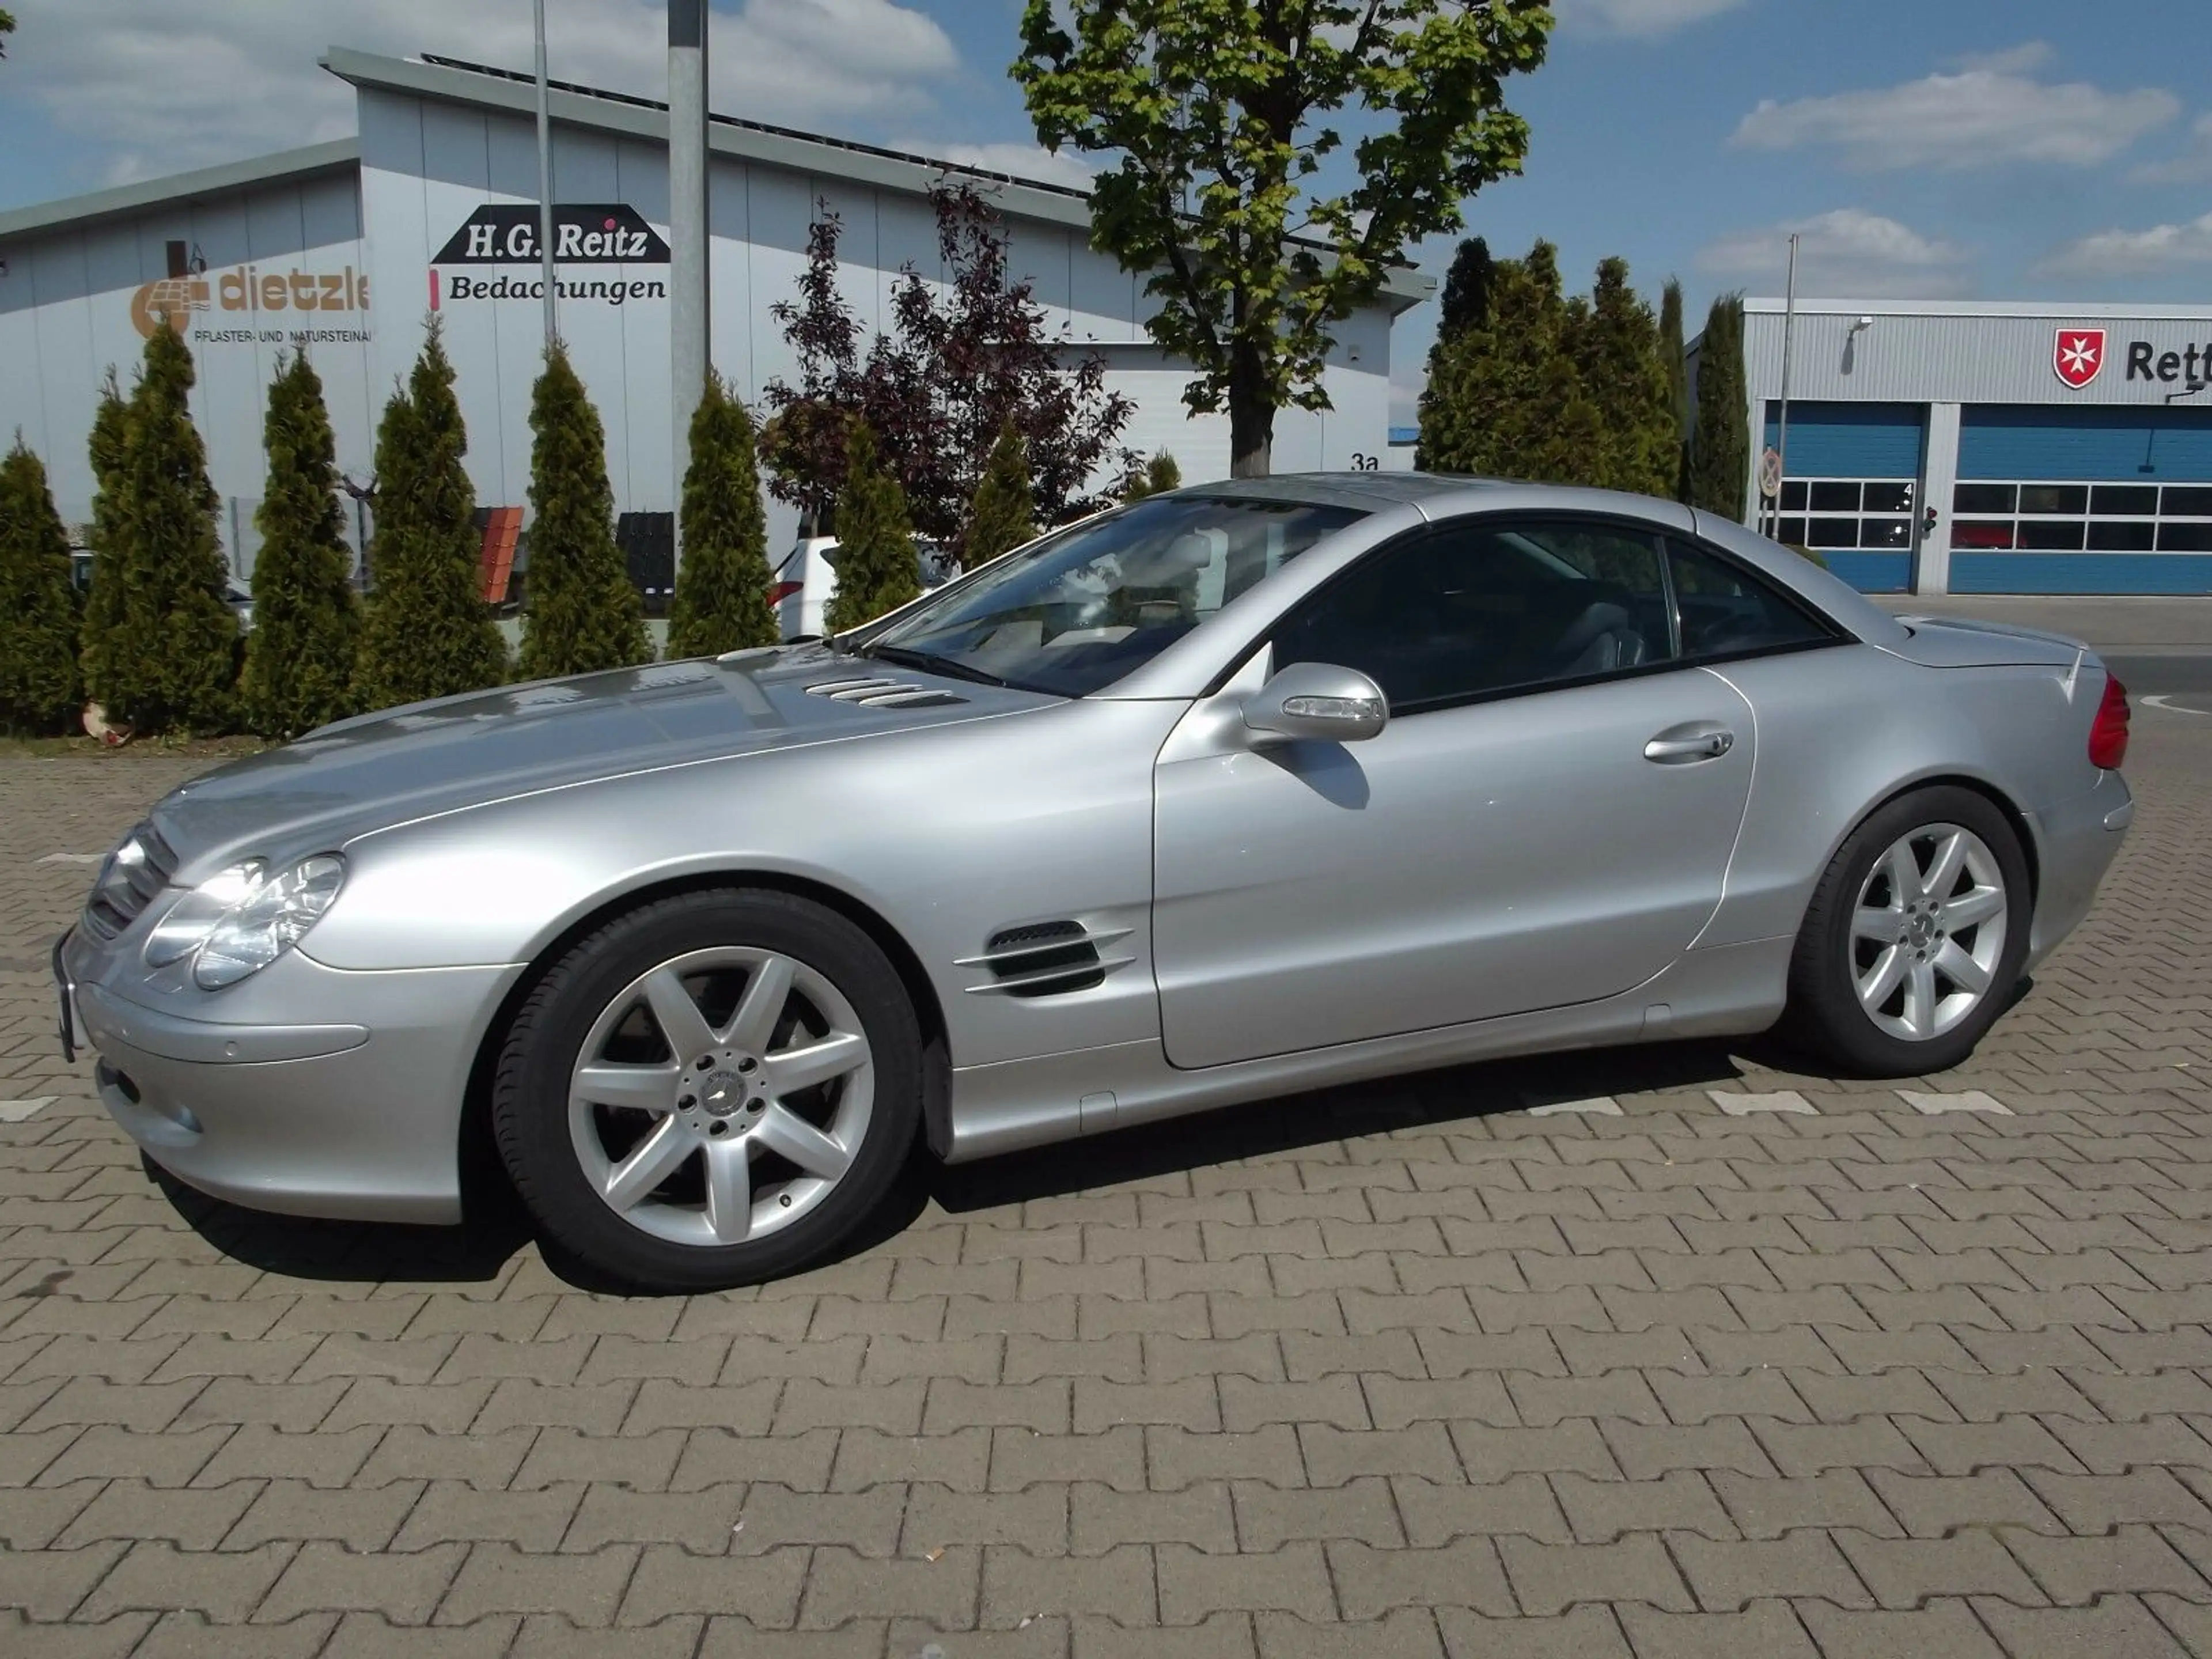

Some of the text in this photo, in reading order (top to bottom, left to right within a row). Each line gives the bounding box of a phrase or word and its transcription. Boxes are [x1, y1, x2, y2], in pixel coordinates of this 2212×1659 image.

[465, 218, 648, 257] H.G. Reitz
[450, 275, 666, 305] Bedachungen
[259, 330, 283, 342] UND
[290, 330, 372, 342] NATURSTEINA
[2126, 341, 2212, 382] Rett
[1351, 453, 1378, 471] 3a
[1904, 483, 1912, 495] 4
